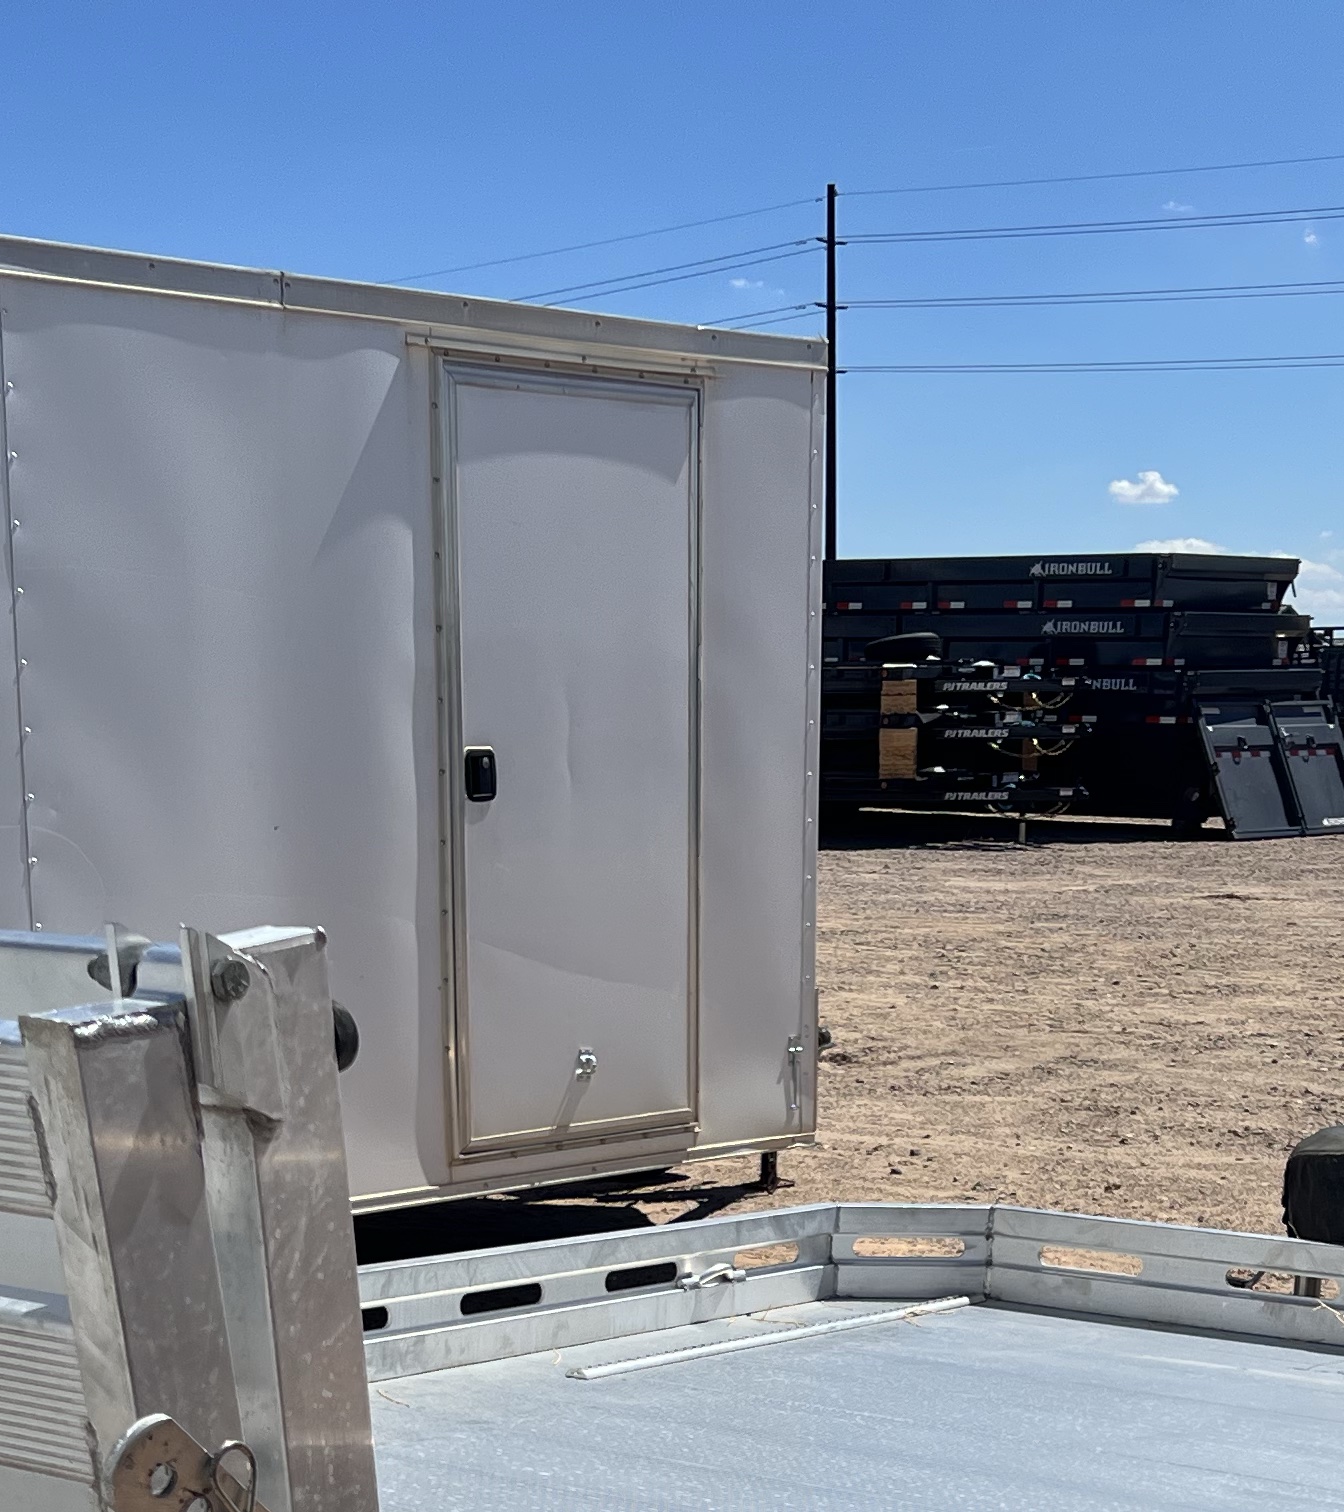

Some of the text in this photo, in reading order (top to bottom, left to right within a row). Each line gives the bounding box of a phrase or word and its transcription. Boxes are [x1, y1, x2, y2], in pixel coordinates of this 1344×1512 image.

[1044, 562, 1113, 575] IRONBULL
[1056, 621, 1124, 633] IRONBULL
[1091, 679, 1137, 691] NBULL
